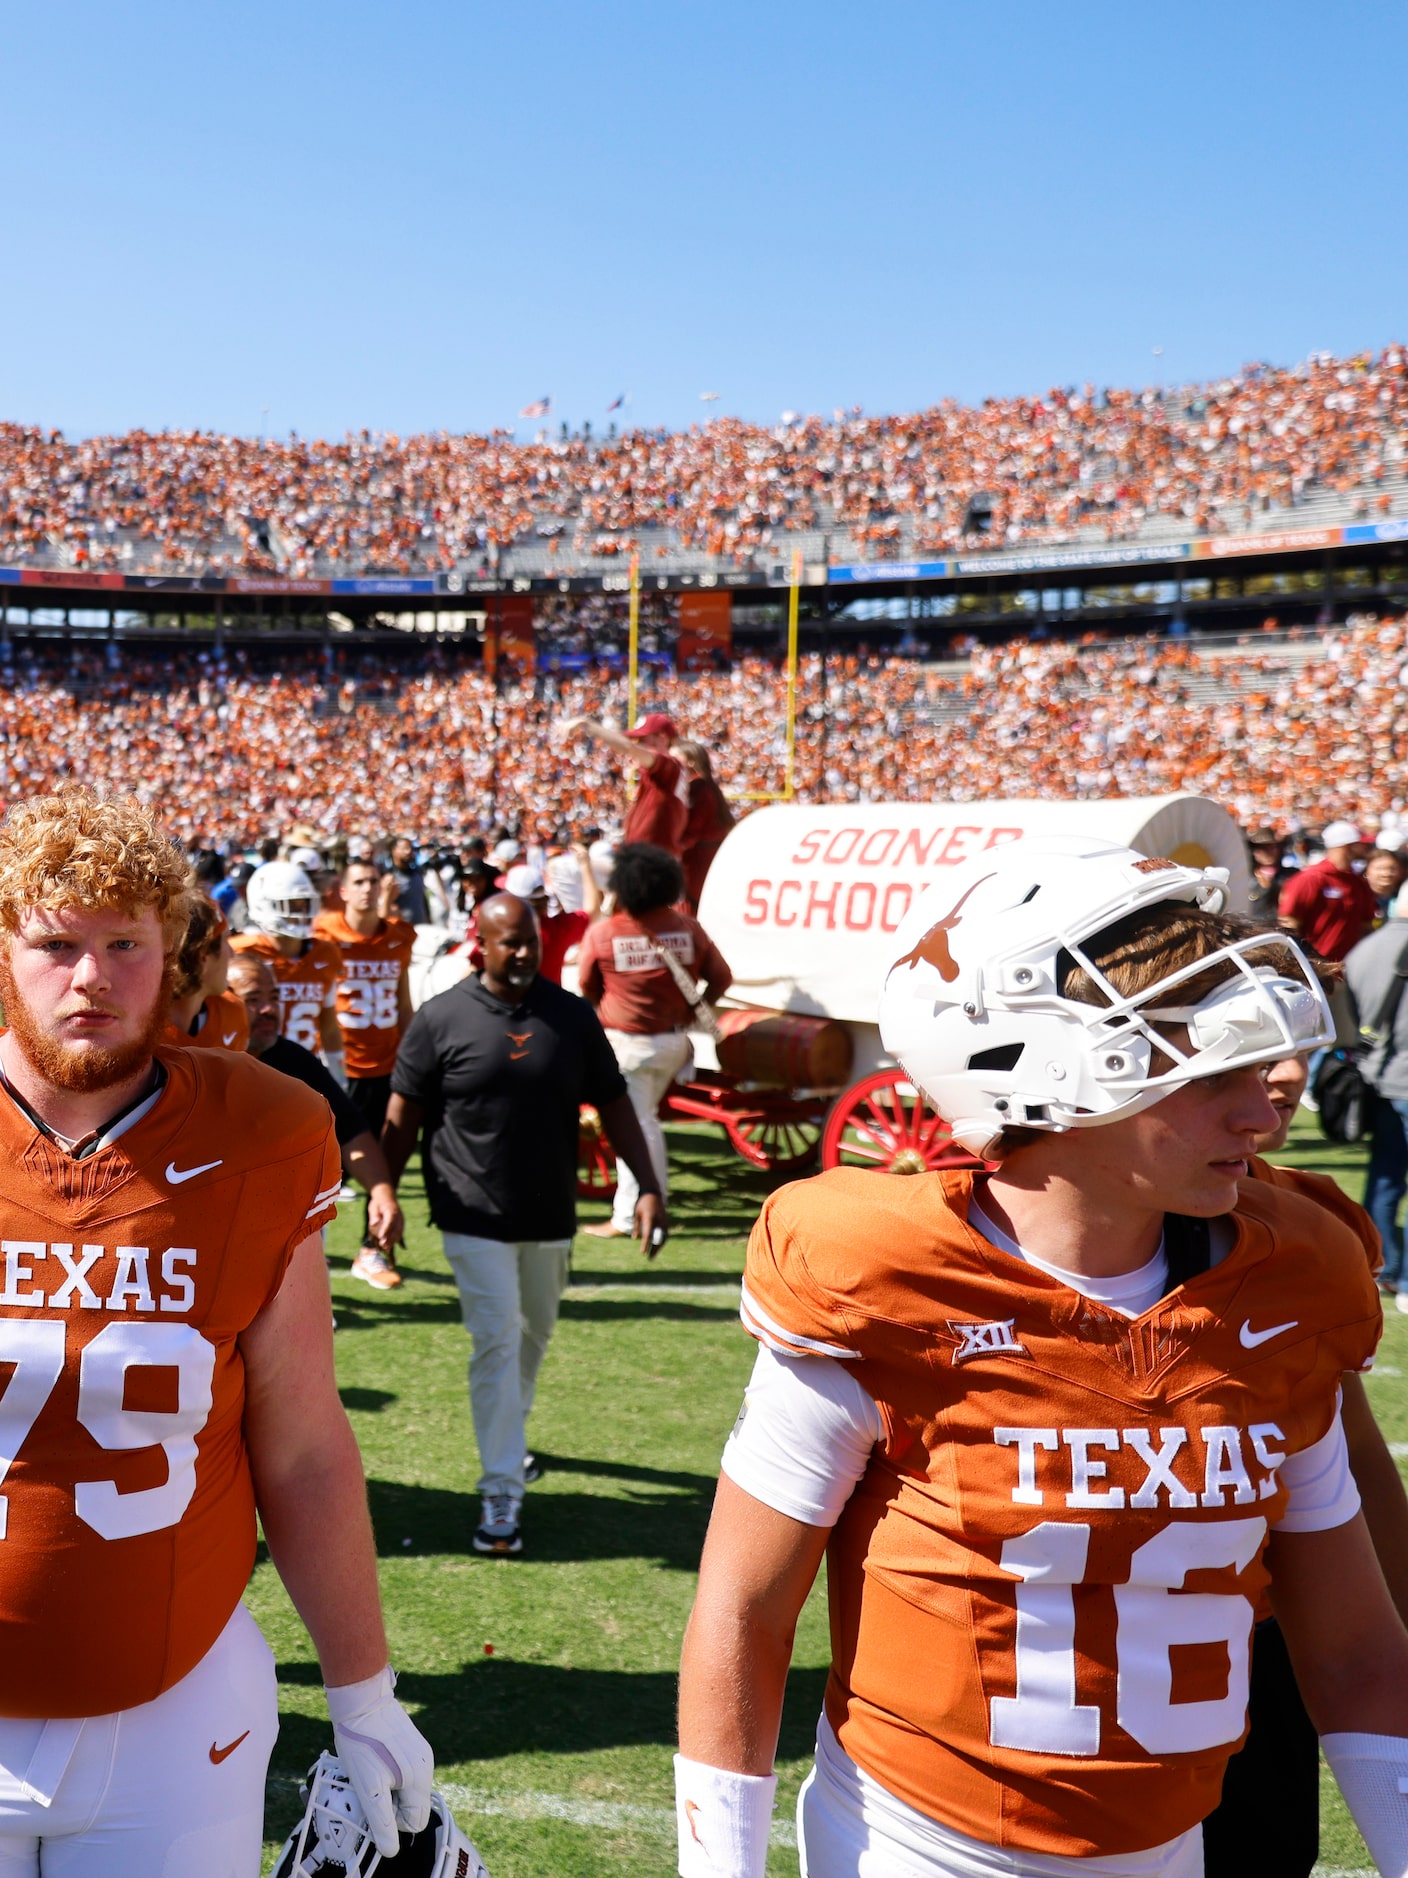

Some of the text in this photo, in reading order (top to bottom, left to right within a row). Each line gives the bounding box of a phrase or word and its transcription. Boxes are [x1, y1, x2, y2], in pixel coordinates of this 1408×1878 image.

[958, 558, 1016, 572] WELCOME
[743, 879, 930, 932] SCHOO
[343, 960, 401, 979] TEXAS
[276, 983, 324, 1001] EXAS
[954, 1318, 1025, 1360] XII
[994, 1422, 1287, 1508] TEXAS
[990, 1515, 1267, 1756] 16
